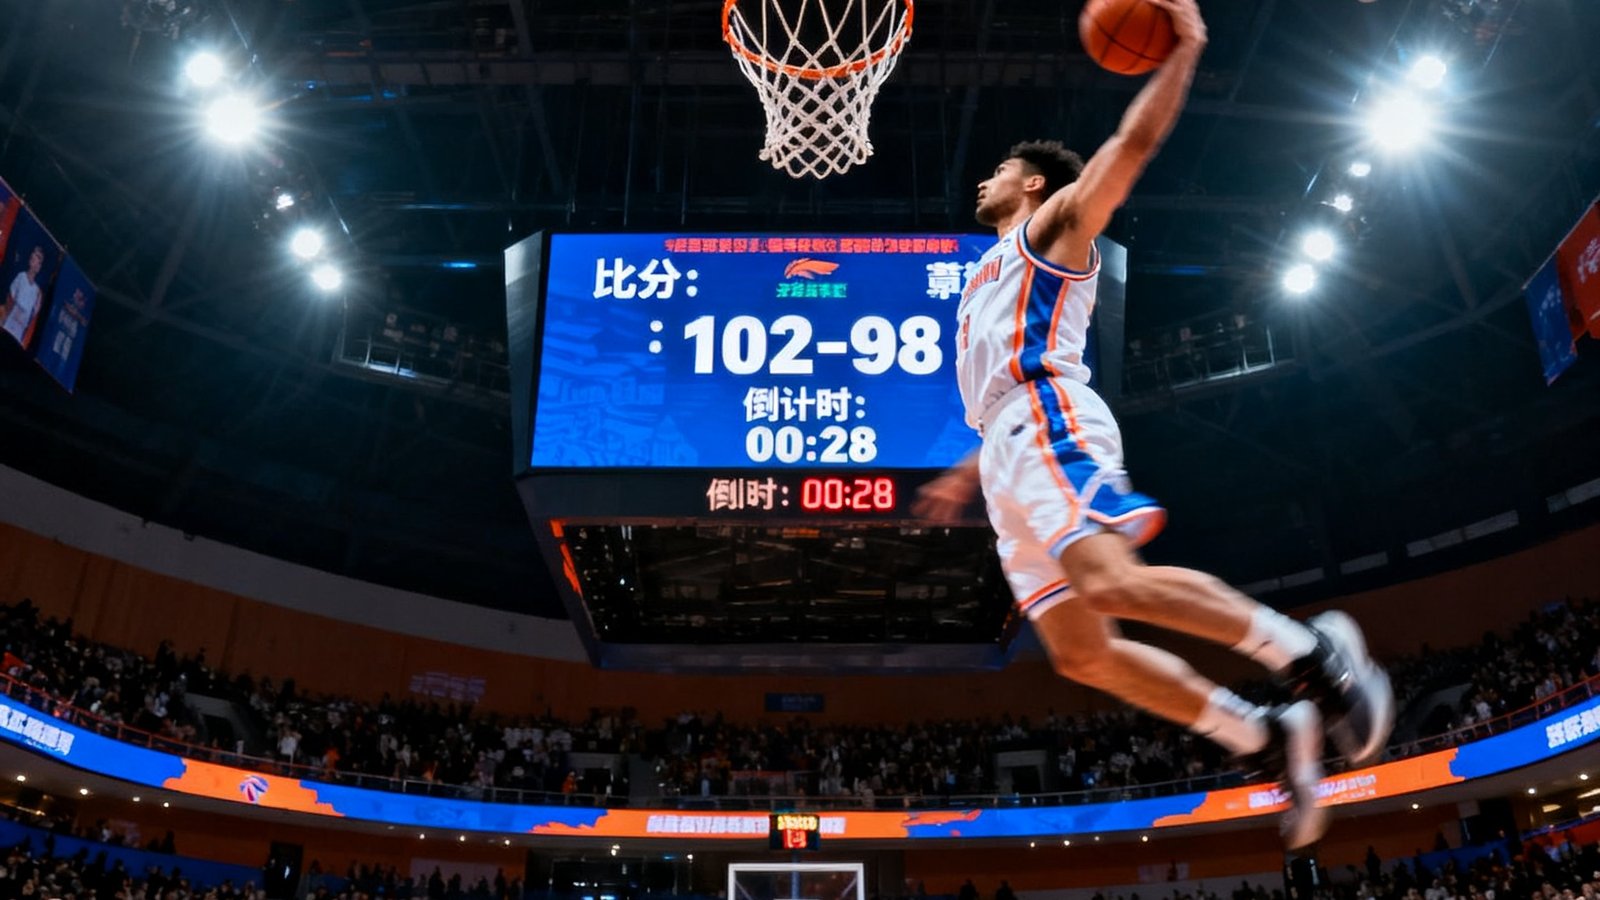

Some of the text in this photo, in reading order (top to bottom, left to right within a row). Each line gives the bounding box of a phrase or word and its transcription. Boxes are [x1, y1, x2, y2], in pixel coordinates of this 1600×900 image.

[593, 258, 699, 300] 比分：
[683, 314, 943, 376] 102-98
[743, 387, 866, 423] 倒计时：
[745, 426, 878, 464] 00:28
[706, 477, 896, 512] 倒时： 00:28
